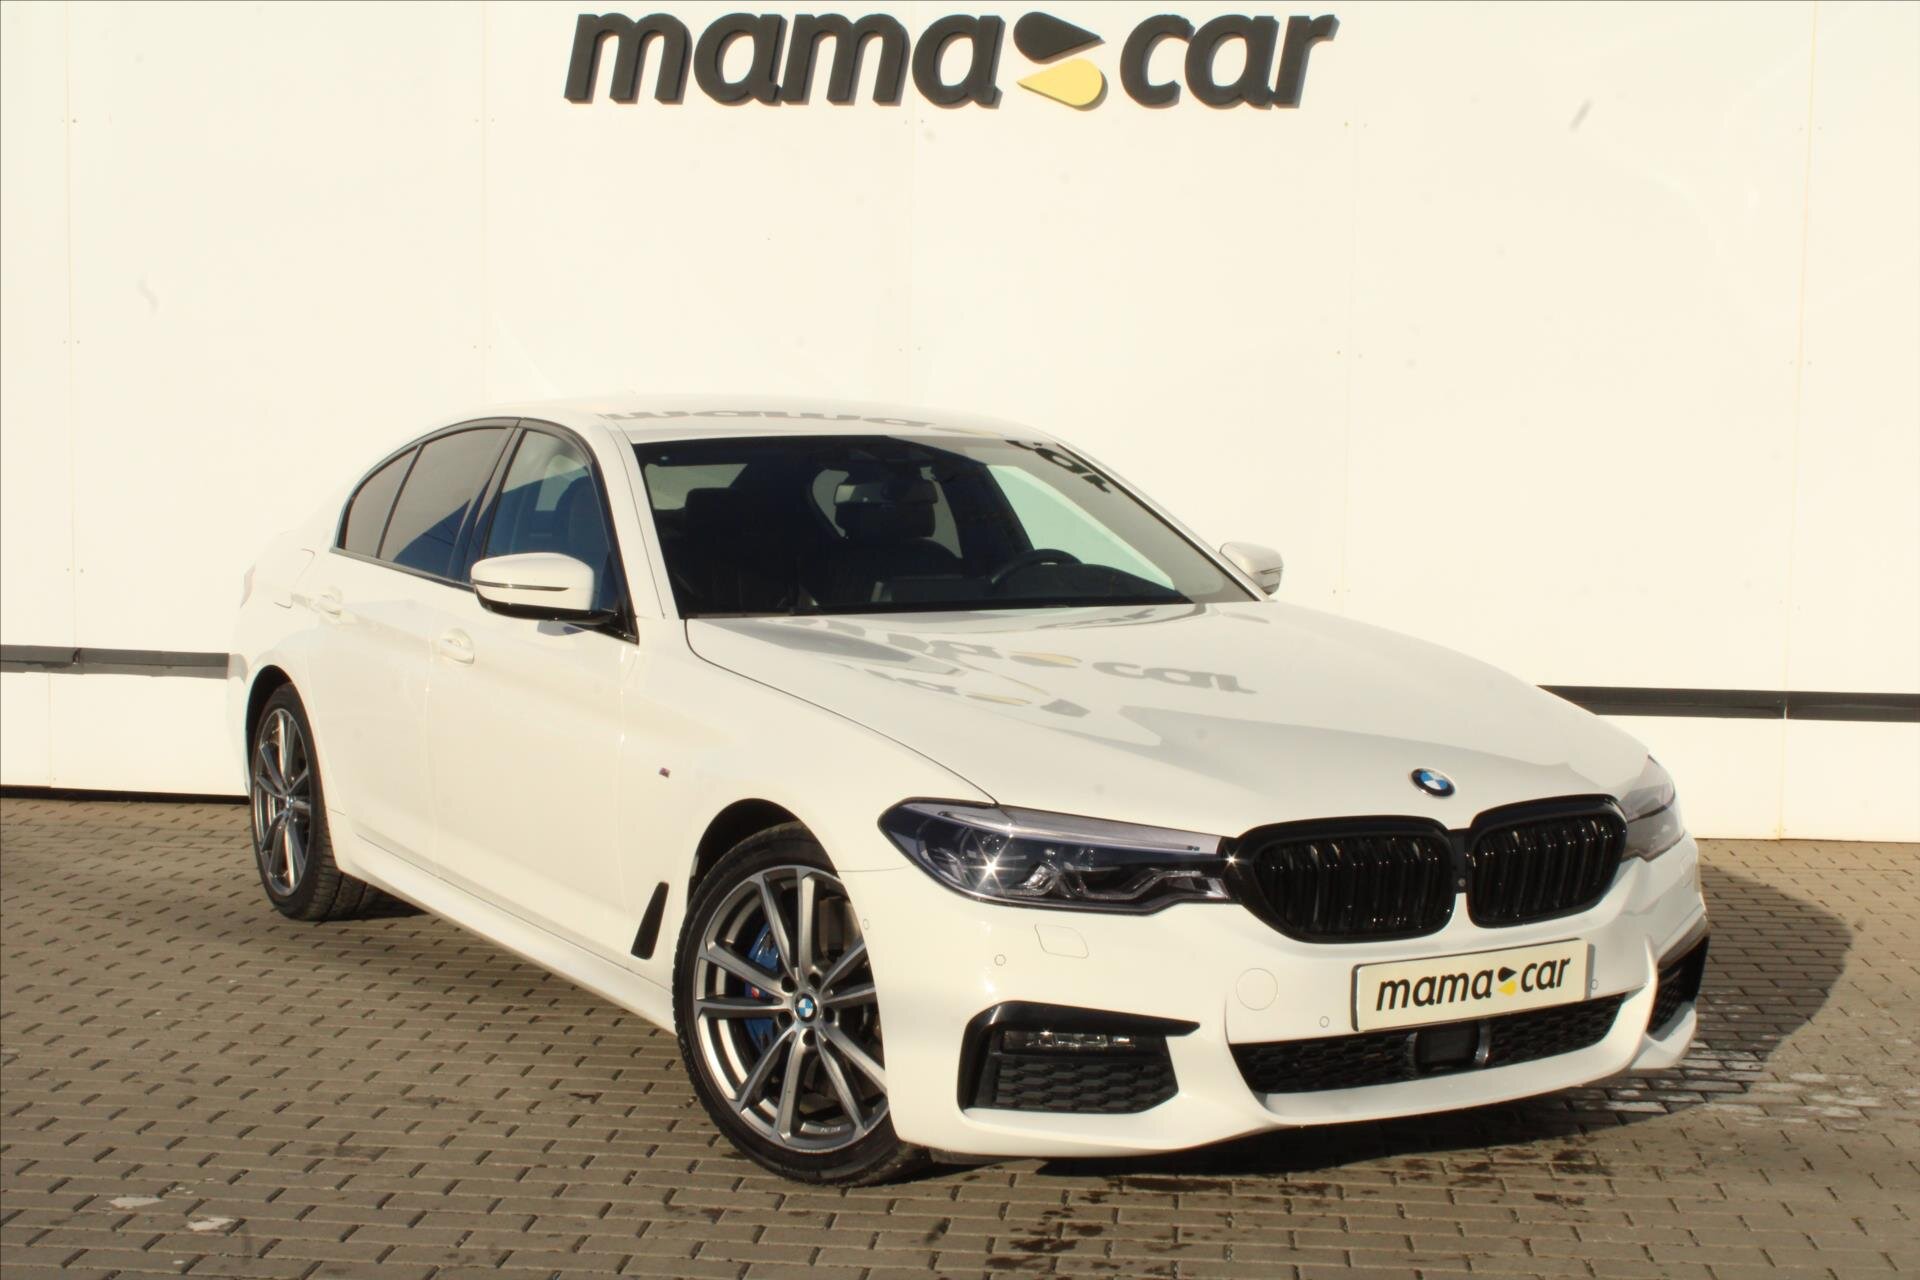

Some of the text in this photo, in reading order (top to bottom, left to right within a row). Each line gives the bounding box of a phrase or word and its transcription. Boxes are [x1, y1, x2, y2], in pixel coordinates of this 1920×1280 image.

[564, 12, 1340, 109] mama car
[1375, 957, 1571, 1011] mama car
